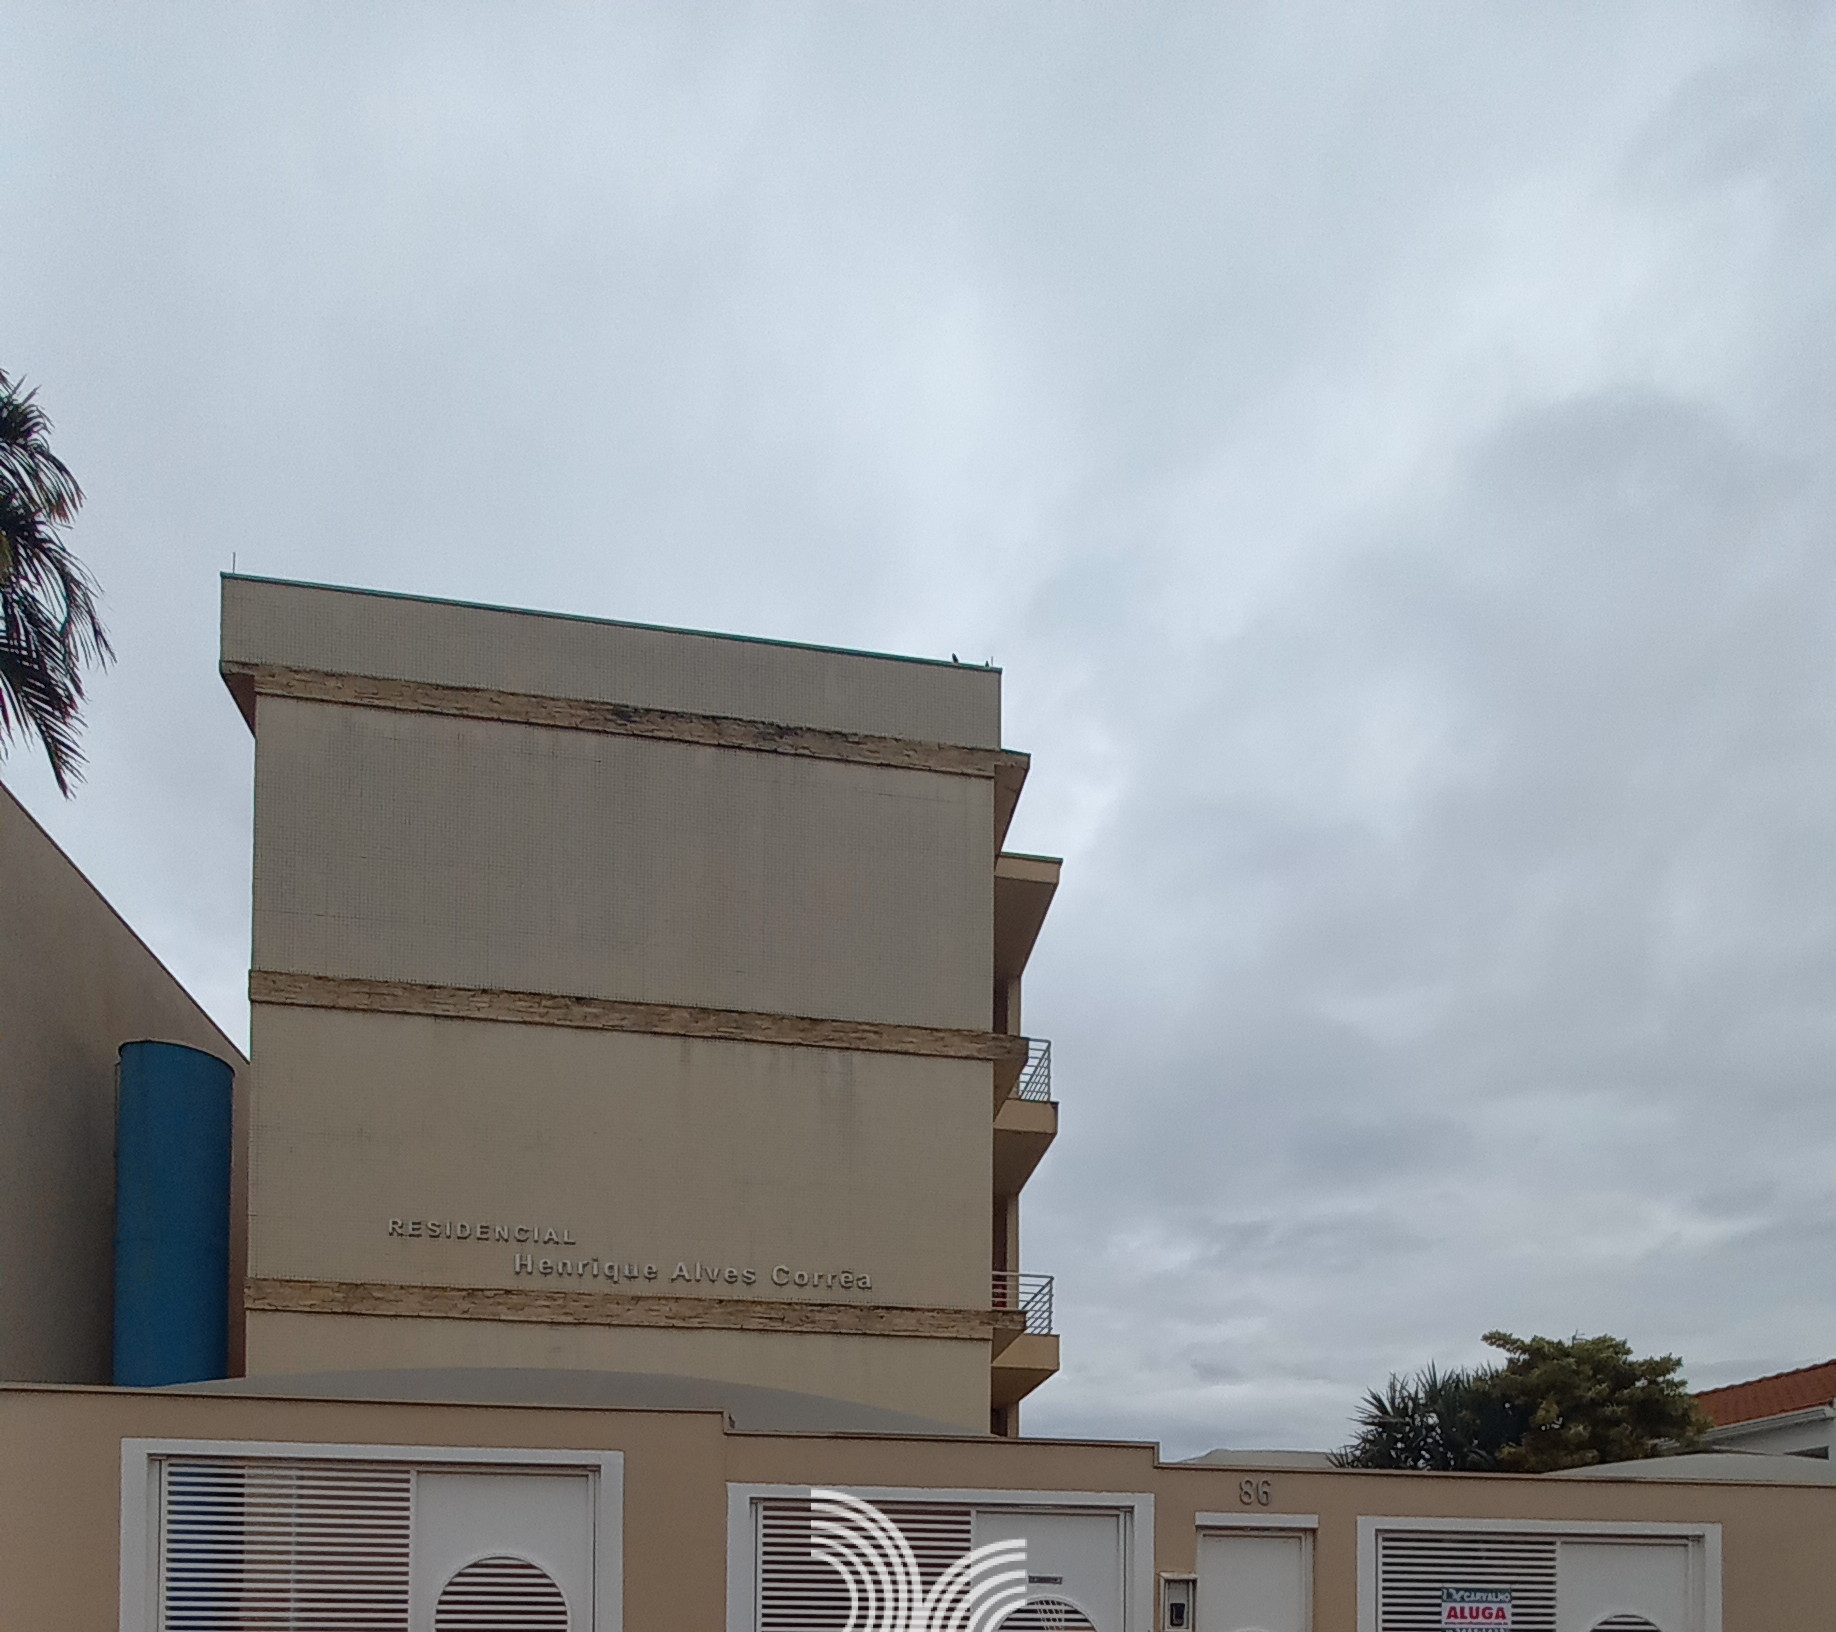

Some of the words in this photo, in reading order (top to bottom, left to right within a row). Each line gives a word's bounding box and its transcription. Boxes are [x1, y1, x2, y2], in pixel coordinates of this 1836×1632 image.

[388, 1218, 576, 1246] RESIDENCIAL
[514, 1253, 658, 1284] Henrique
[671, 1261, 757, 1286] Alves
[1239, 1478, 1272, 1507] 86
[1463, 1591, 1511, 1602] CARVALHO
[1446, 1605, 1507, 1620] ALUGA
